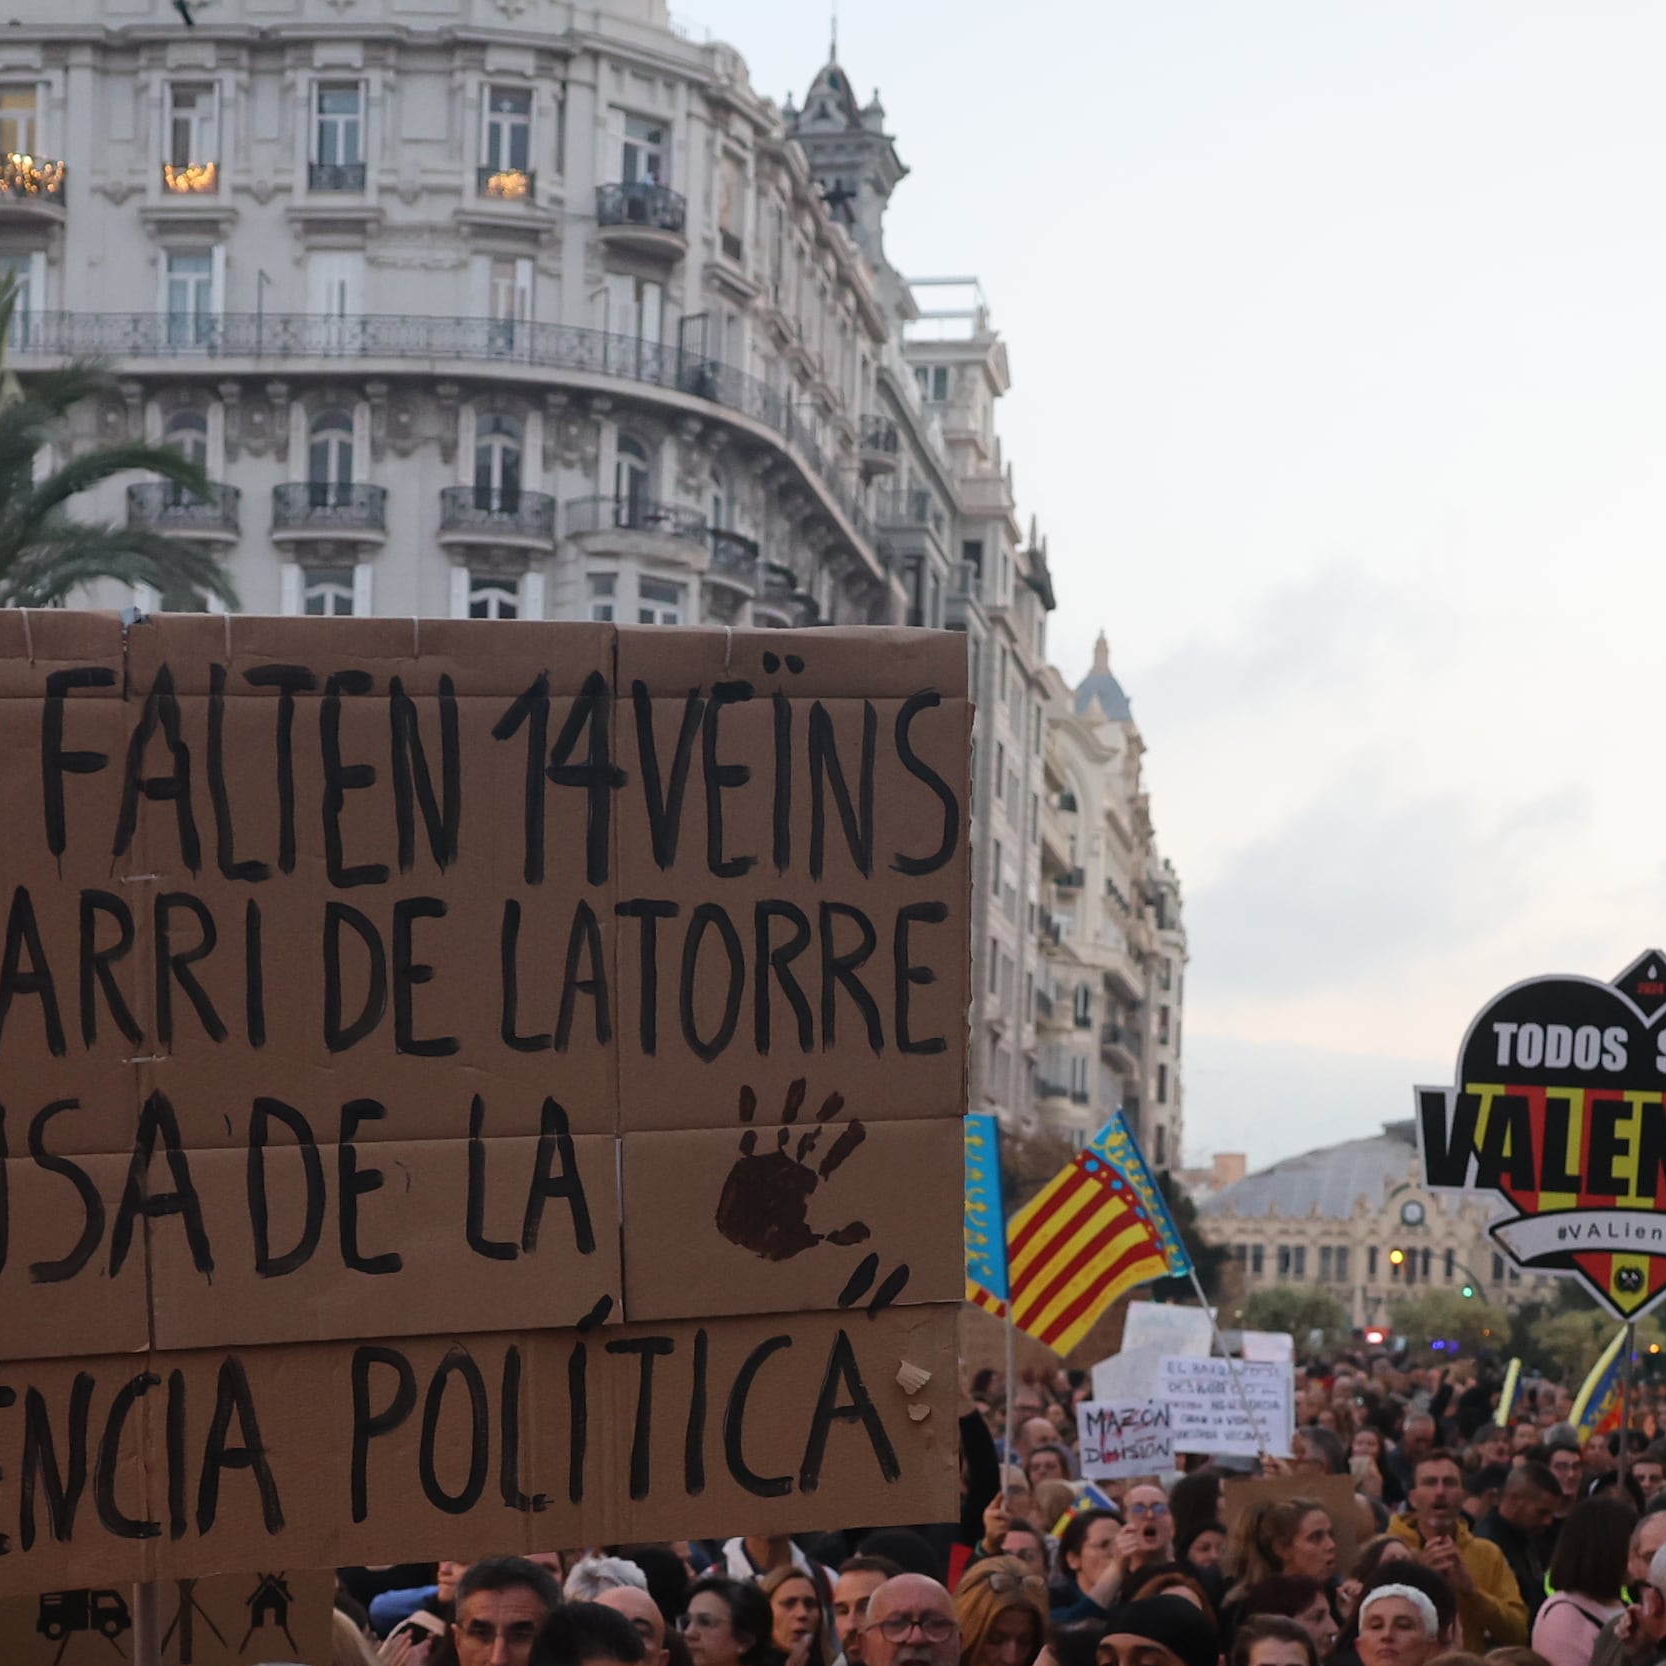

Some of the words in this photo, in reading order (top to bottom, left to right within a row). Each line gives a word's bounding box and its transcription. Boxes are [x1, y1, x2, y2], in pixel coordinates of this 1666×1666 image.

[42, 662, 461, 887] FALTEN
[491, 668, 627, 886] 14
[632, 652, 961, 879] VEÏNS
[323, 896, 460, 1058] DE
[1492, 1022, 1629, 1072] TODOS
[247, 1095, 403, 1277] DE
[465, 1092, 599, 1256] LA
